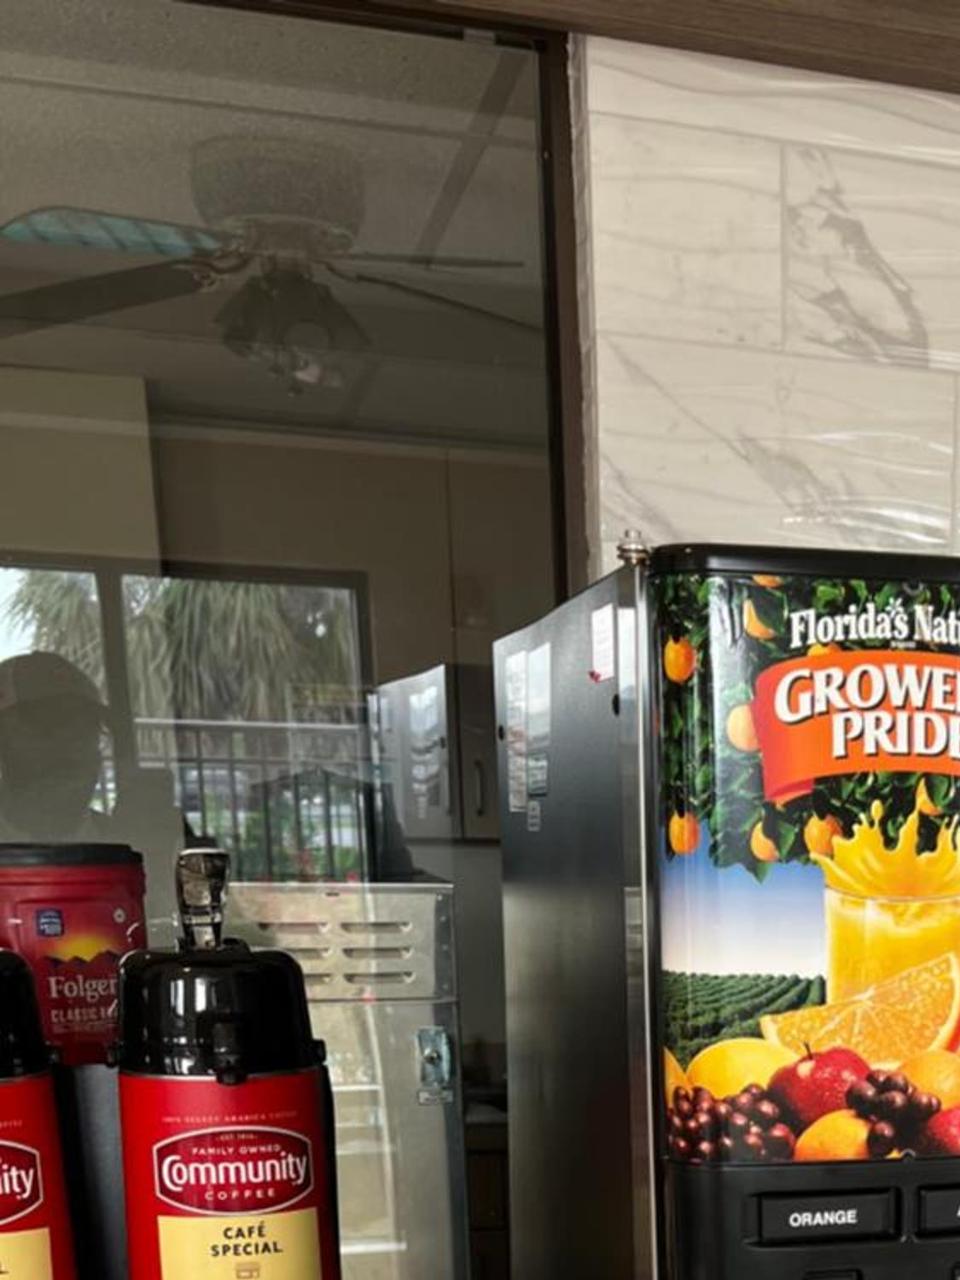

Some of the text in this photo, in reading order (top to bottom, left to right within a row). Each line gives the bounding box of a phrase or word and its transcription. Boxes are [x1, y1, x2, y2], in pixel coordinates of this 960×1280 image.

[789, 602, 908, 649] Florida's
[47, 974, 118, 1003] Folger
[192, 1144, 281, 1156] FAMILY OWNED
[161, 1151, 307, 1192] Community
[204, 1188, 275, 1201] COFFEE
[789, 1209, 858, 1228] ORANGE
[223, 1221, 267, 1240] CAFÉ
[211, 1241, 283, 1258] SPECIAL
